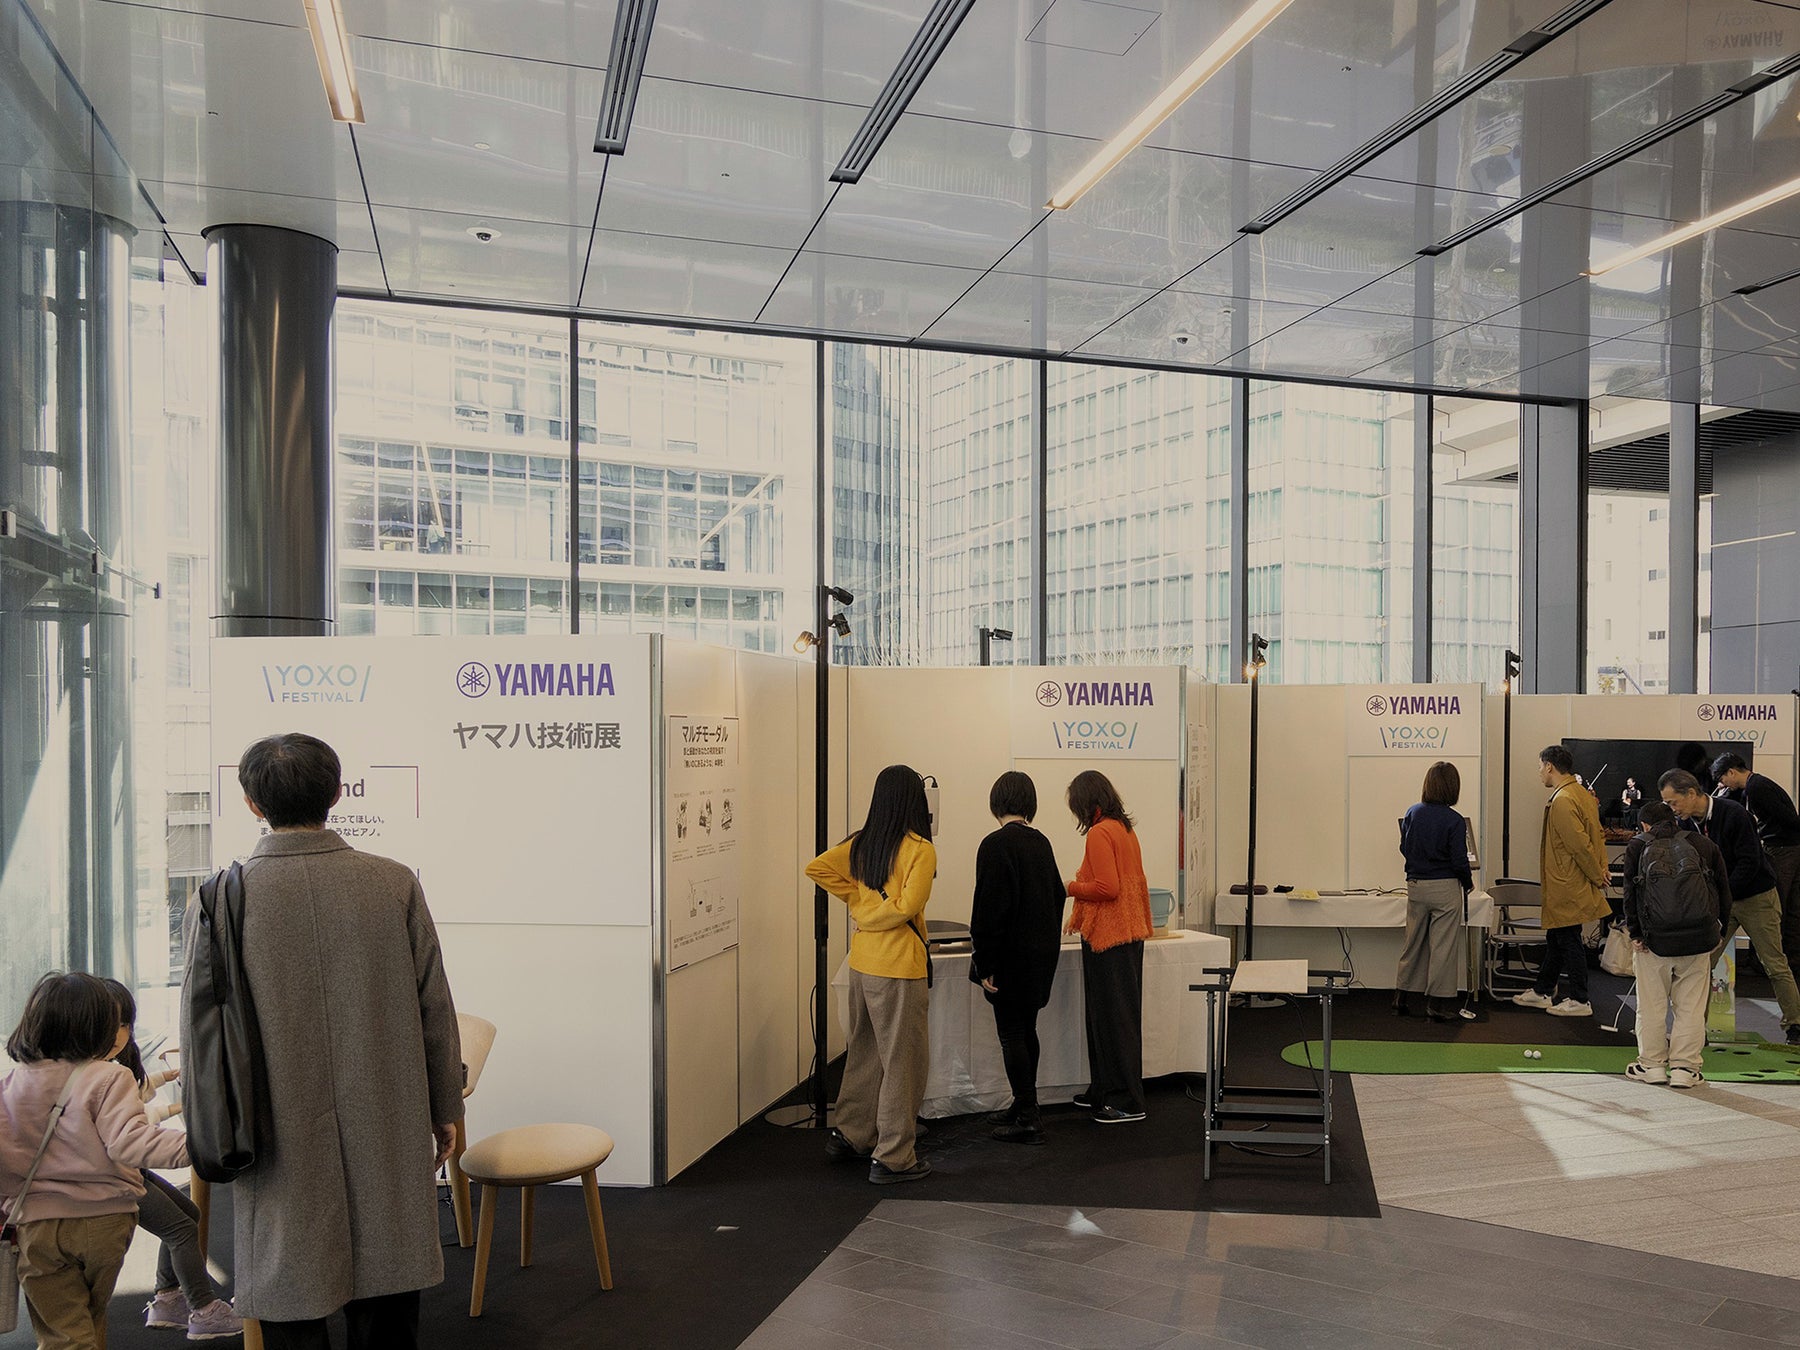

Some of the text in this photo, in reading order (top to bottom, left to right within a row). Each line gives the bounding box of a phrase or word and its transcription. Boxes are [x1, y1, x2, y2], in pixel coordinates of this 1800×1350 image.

[275, 664, 357, 687] YOXO
[494, 663, 616, 697] YAMAHA
[281, 691, 354, 704] FESTIVAL
[1064, 682, 1154, 707] YAMAHA
[1389, 695, 1461, 715] YAMAHA
[1716, 704, 1777, 721] YAMAHA
[452, 721, 622, 750] ヤマハ技術展
[681, 725, 729, 743] マルチモーダル
[1063, 721, 1127, 738] YOXO
[1387, 726, 1440, 740] YOXO
[1715, 729, 1759, 741] YOXO
[1067, 740, 1124, 750] FESTIVAL
[1391, 741, 1438, 749] FESTIVAL
